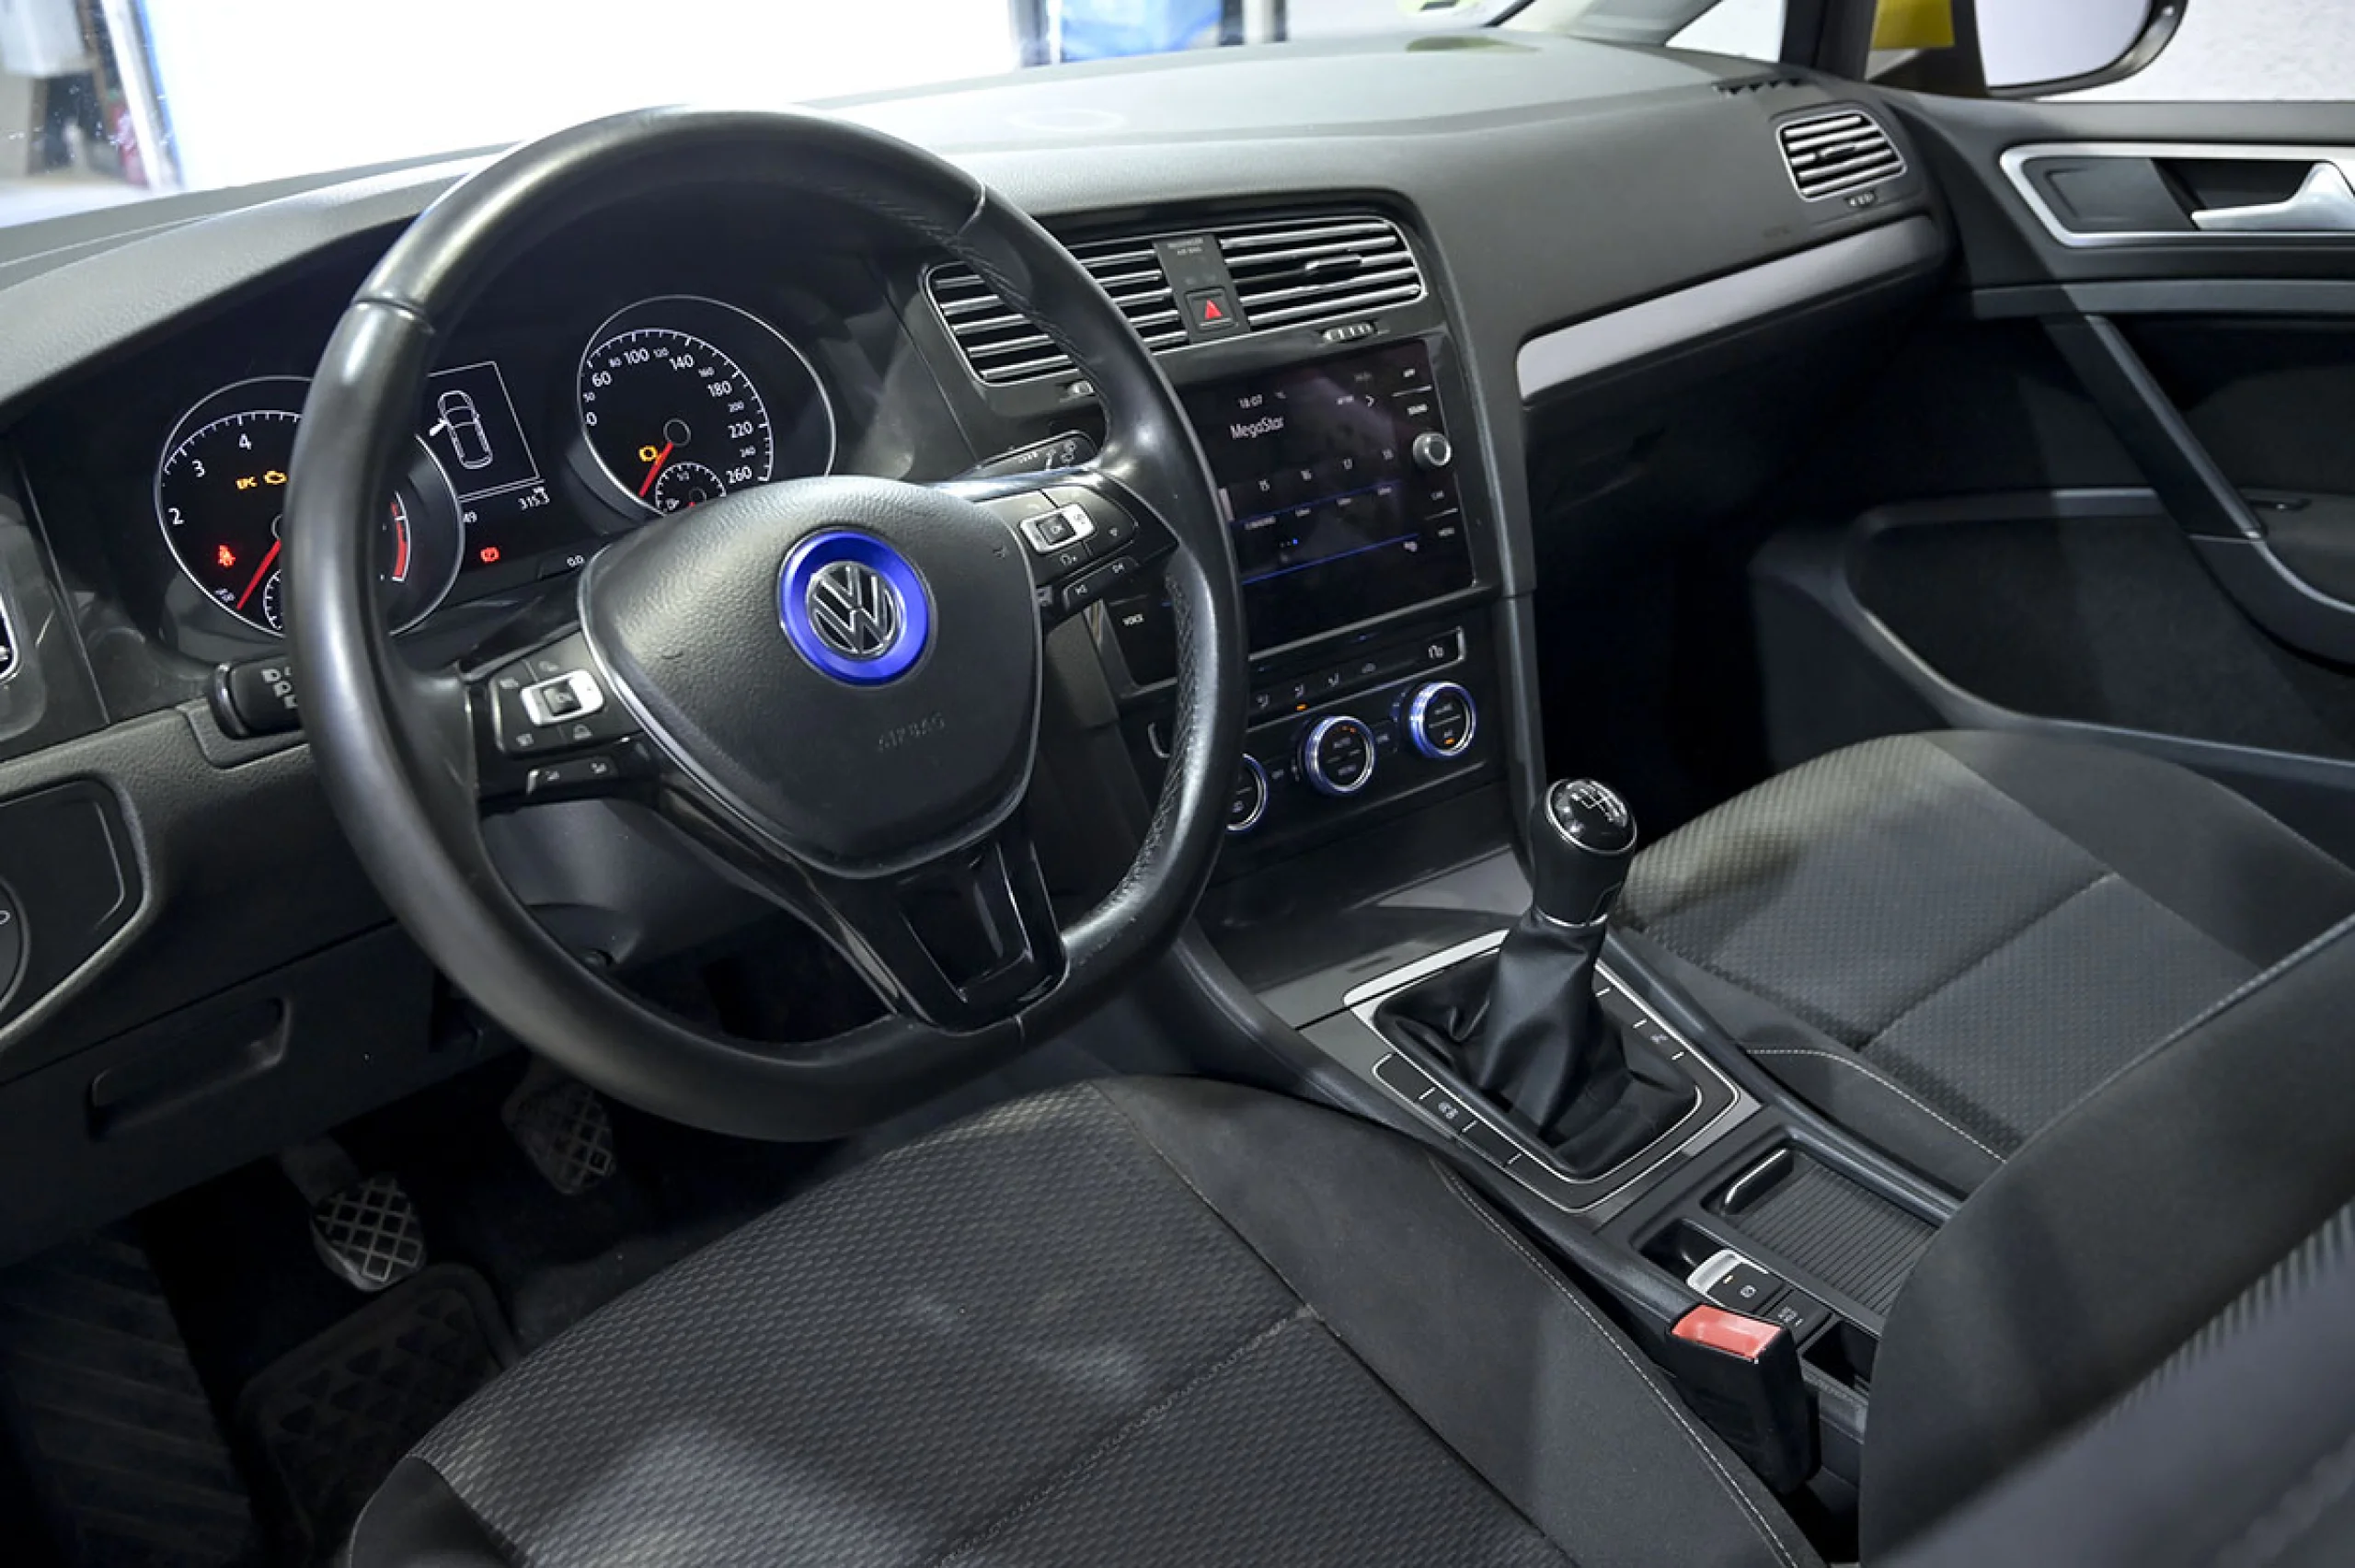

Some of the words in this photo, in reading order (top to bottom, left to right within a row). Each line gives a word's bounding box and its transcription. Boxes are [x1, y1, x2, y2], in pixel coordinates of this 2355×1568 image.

[624, 348, 650, 365] 100
[669, 354, 695, 371] 140
[592, 370, 613, 387] 60
[707, 380, 733, 397] 180
[585, 411, 597, 426] 0
[1230, 416, 1284, 439] MegaStar
[728, 420, 753, 439] 220
[238, 433, 252, 451] 4
[191, 459, 206, 477] 3
[726, 465, 752, 484] 260
[168, 507, 185, 525] 2
